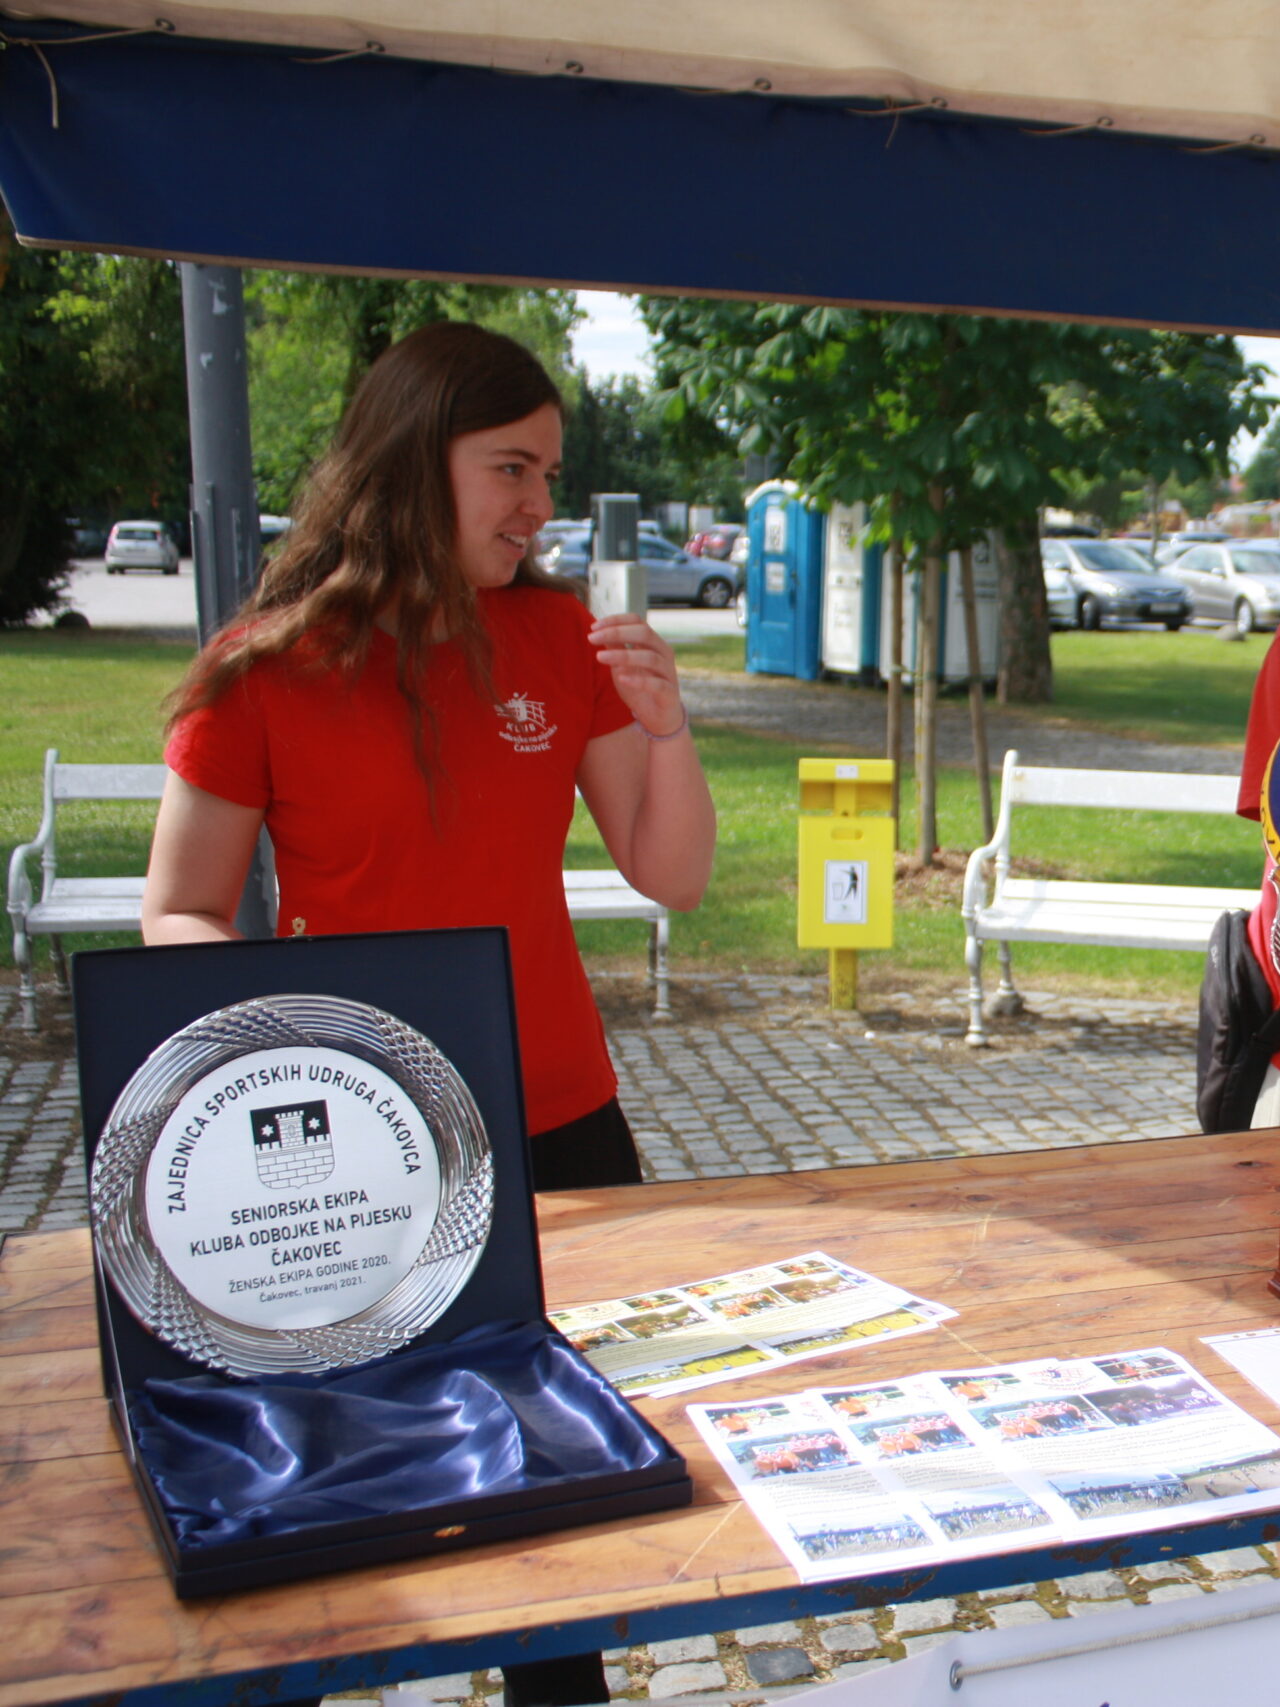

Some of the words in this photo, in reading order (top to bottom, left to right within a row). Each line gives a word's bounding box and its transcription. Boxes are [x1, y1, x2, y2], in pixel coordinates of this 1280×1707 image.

[168, 1116, 210, 1213] ZAJEDNICA
[205, 1064, 300, 1116] SPORTSKIH
[309, 1065, 376, 1104] UDRUGA
[376, 1097, 421, 1175] ČAKOVCA
[231, 1197, 320, 1225] SENIORSKA
[324, 1189, 369, 1209] EKIPA
[190, 1234, 245, 1257] KLUBA
[249, 1221, 320, 1246] ODBOJKE
[324, 1216, 346, 1233] NA
[350, 1205, 412, 1228] PIJESKU
[271, 1241, 342, 1266] ČAKOVEC
[228, 1275, 276, 1294] ŽENSKA
[279, 1268, 313, 1284] EKIPA
[316, 1259, 358, 1277] GODINE
[362, 1255, 391, 1269] 2020.
[259, 1288, 302, 1302] Čakovec,
[305, 1280, 338, 1295] travanj
[340, 1275, 366, 1288] 2021.
